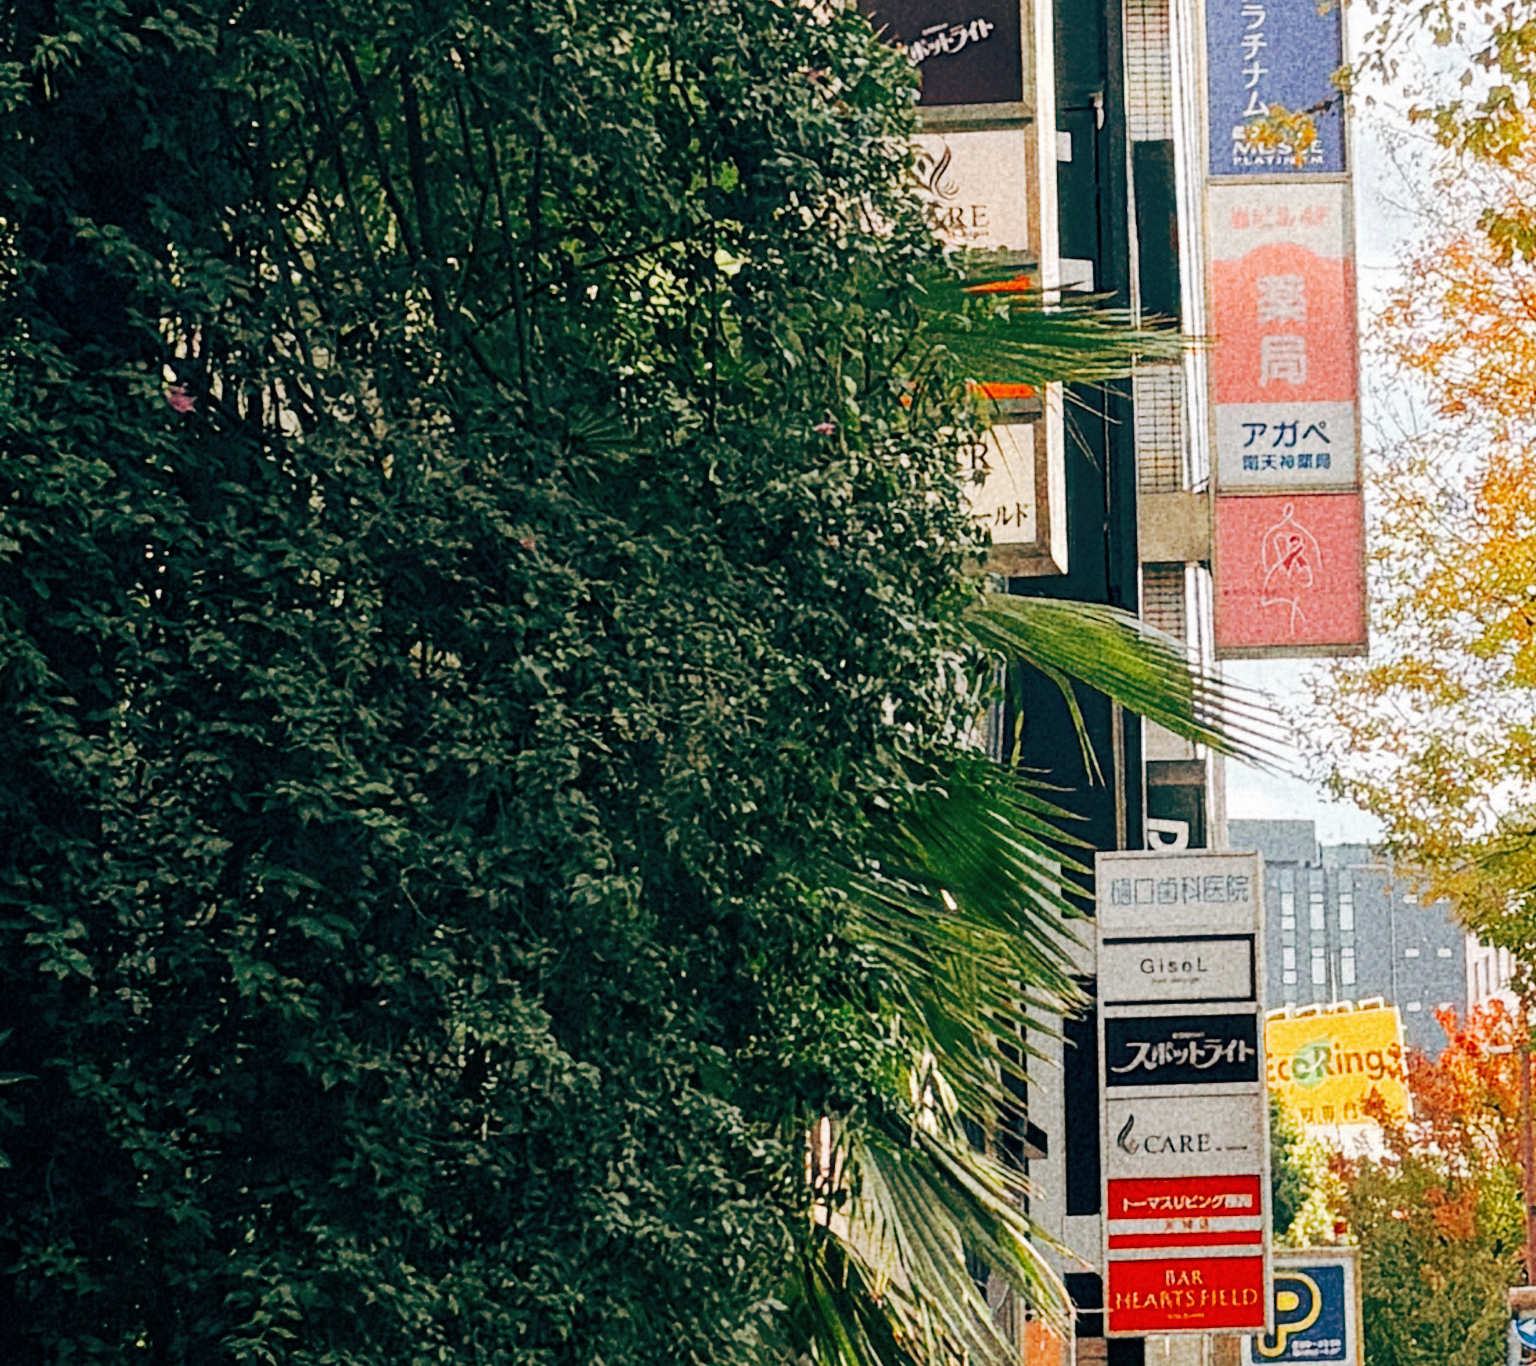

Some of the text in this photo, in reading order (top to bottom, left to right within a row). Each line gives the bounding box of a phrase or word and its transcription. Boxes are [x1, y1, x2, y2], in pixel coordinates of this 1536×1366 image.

[906, 18, 995, 68] ポットライト
[1255, 274, 1309, 388] 薬局
[1241, 419, 1331, 448] アガペ
[1110, 1037, 1256, 1074] スポットライト
[1143, 1134, 1211, 1154] CARE
[1165, 1269, 1204, 1287] BAR
